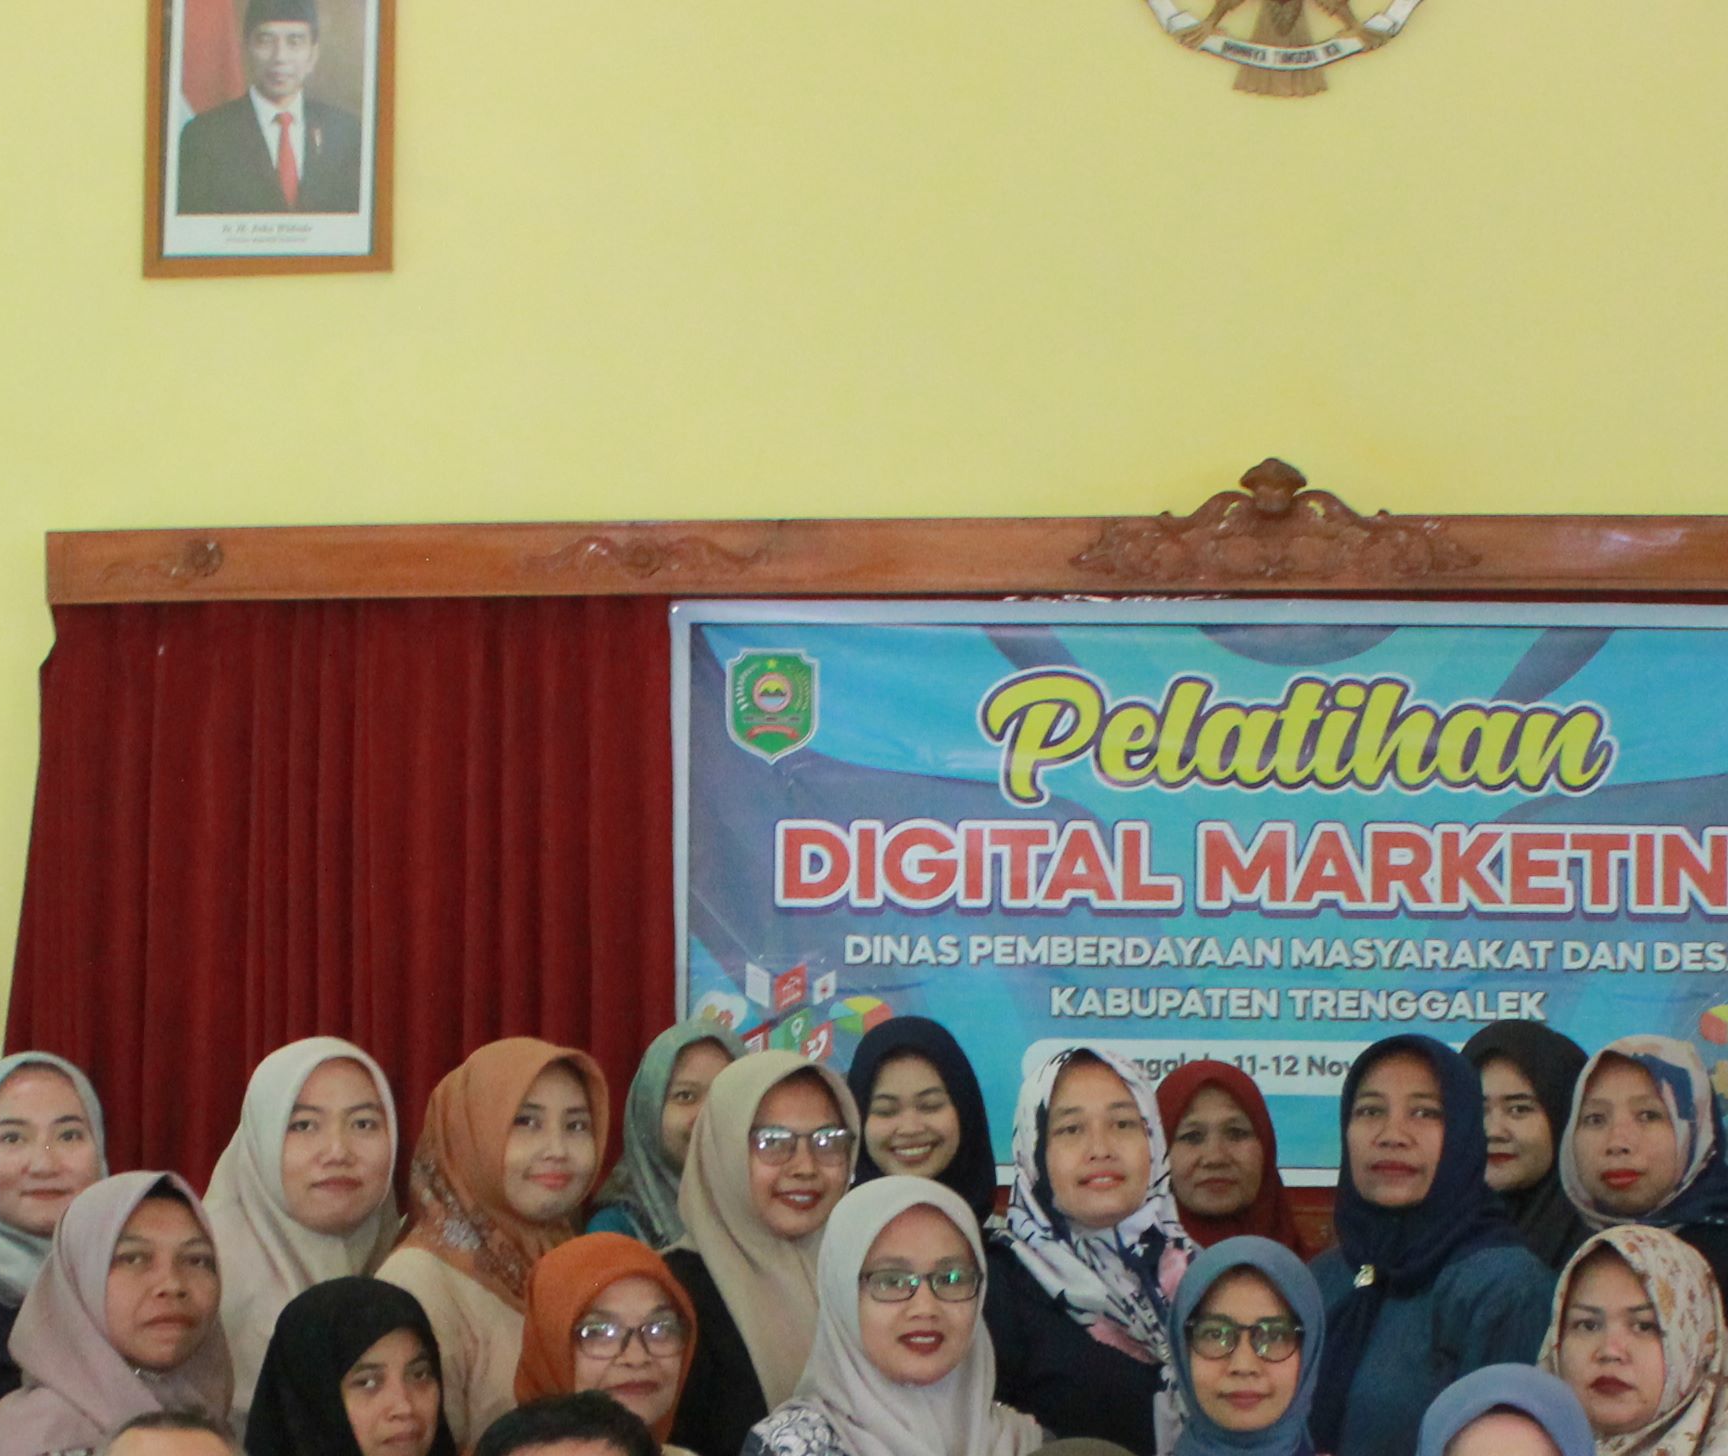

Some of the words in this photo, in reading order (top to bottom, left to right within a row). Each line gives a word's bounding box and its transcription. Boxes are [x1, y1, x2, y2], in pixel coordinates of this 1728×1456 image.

[983, 671, 1613, 803] Pelatihan
[780, 825, 1178, 904] DIGITAL
[844, 936, 959, 966] DINAS
[969, 937, 1282, 969] PEMBERDAYAAN
[1292, 939, 1554, 971] MASYARAKAT
[1562, 941, 1644, 972] DAN
[1050, 988, 1278, 1019] KABUPATEN
[1289, 990, 1546, 1021] TRENGGALEK
